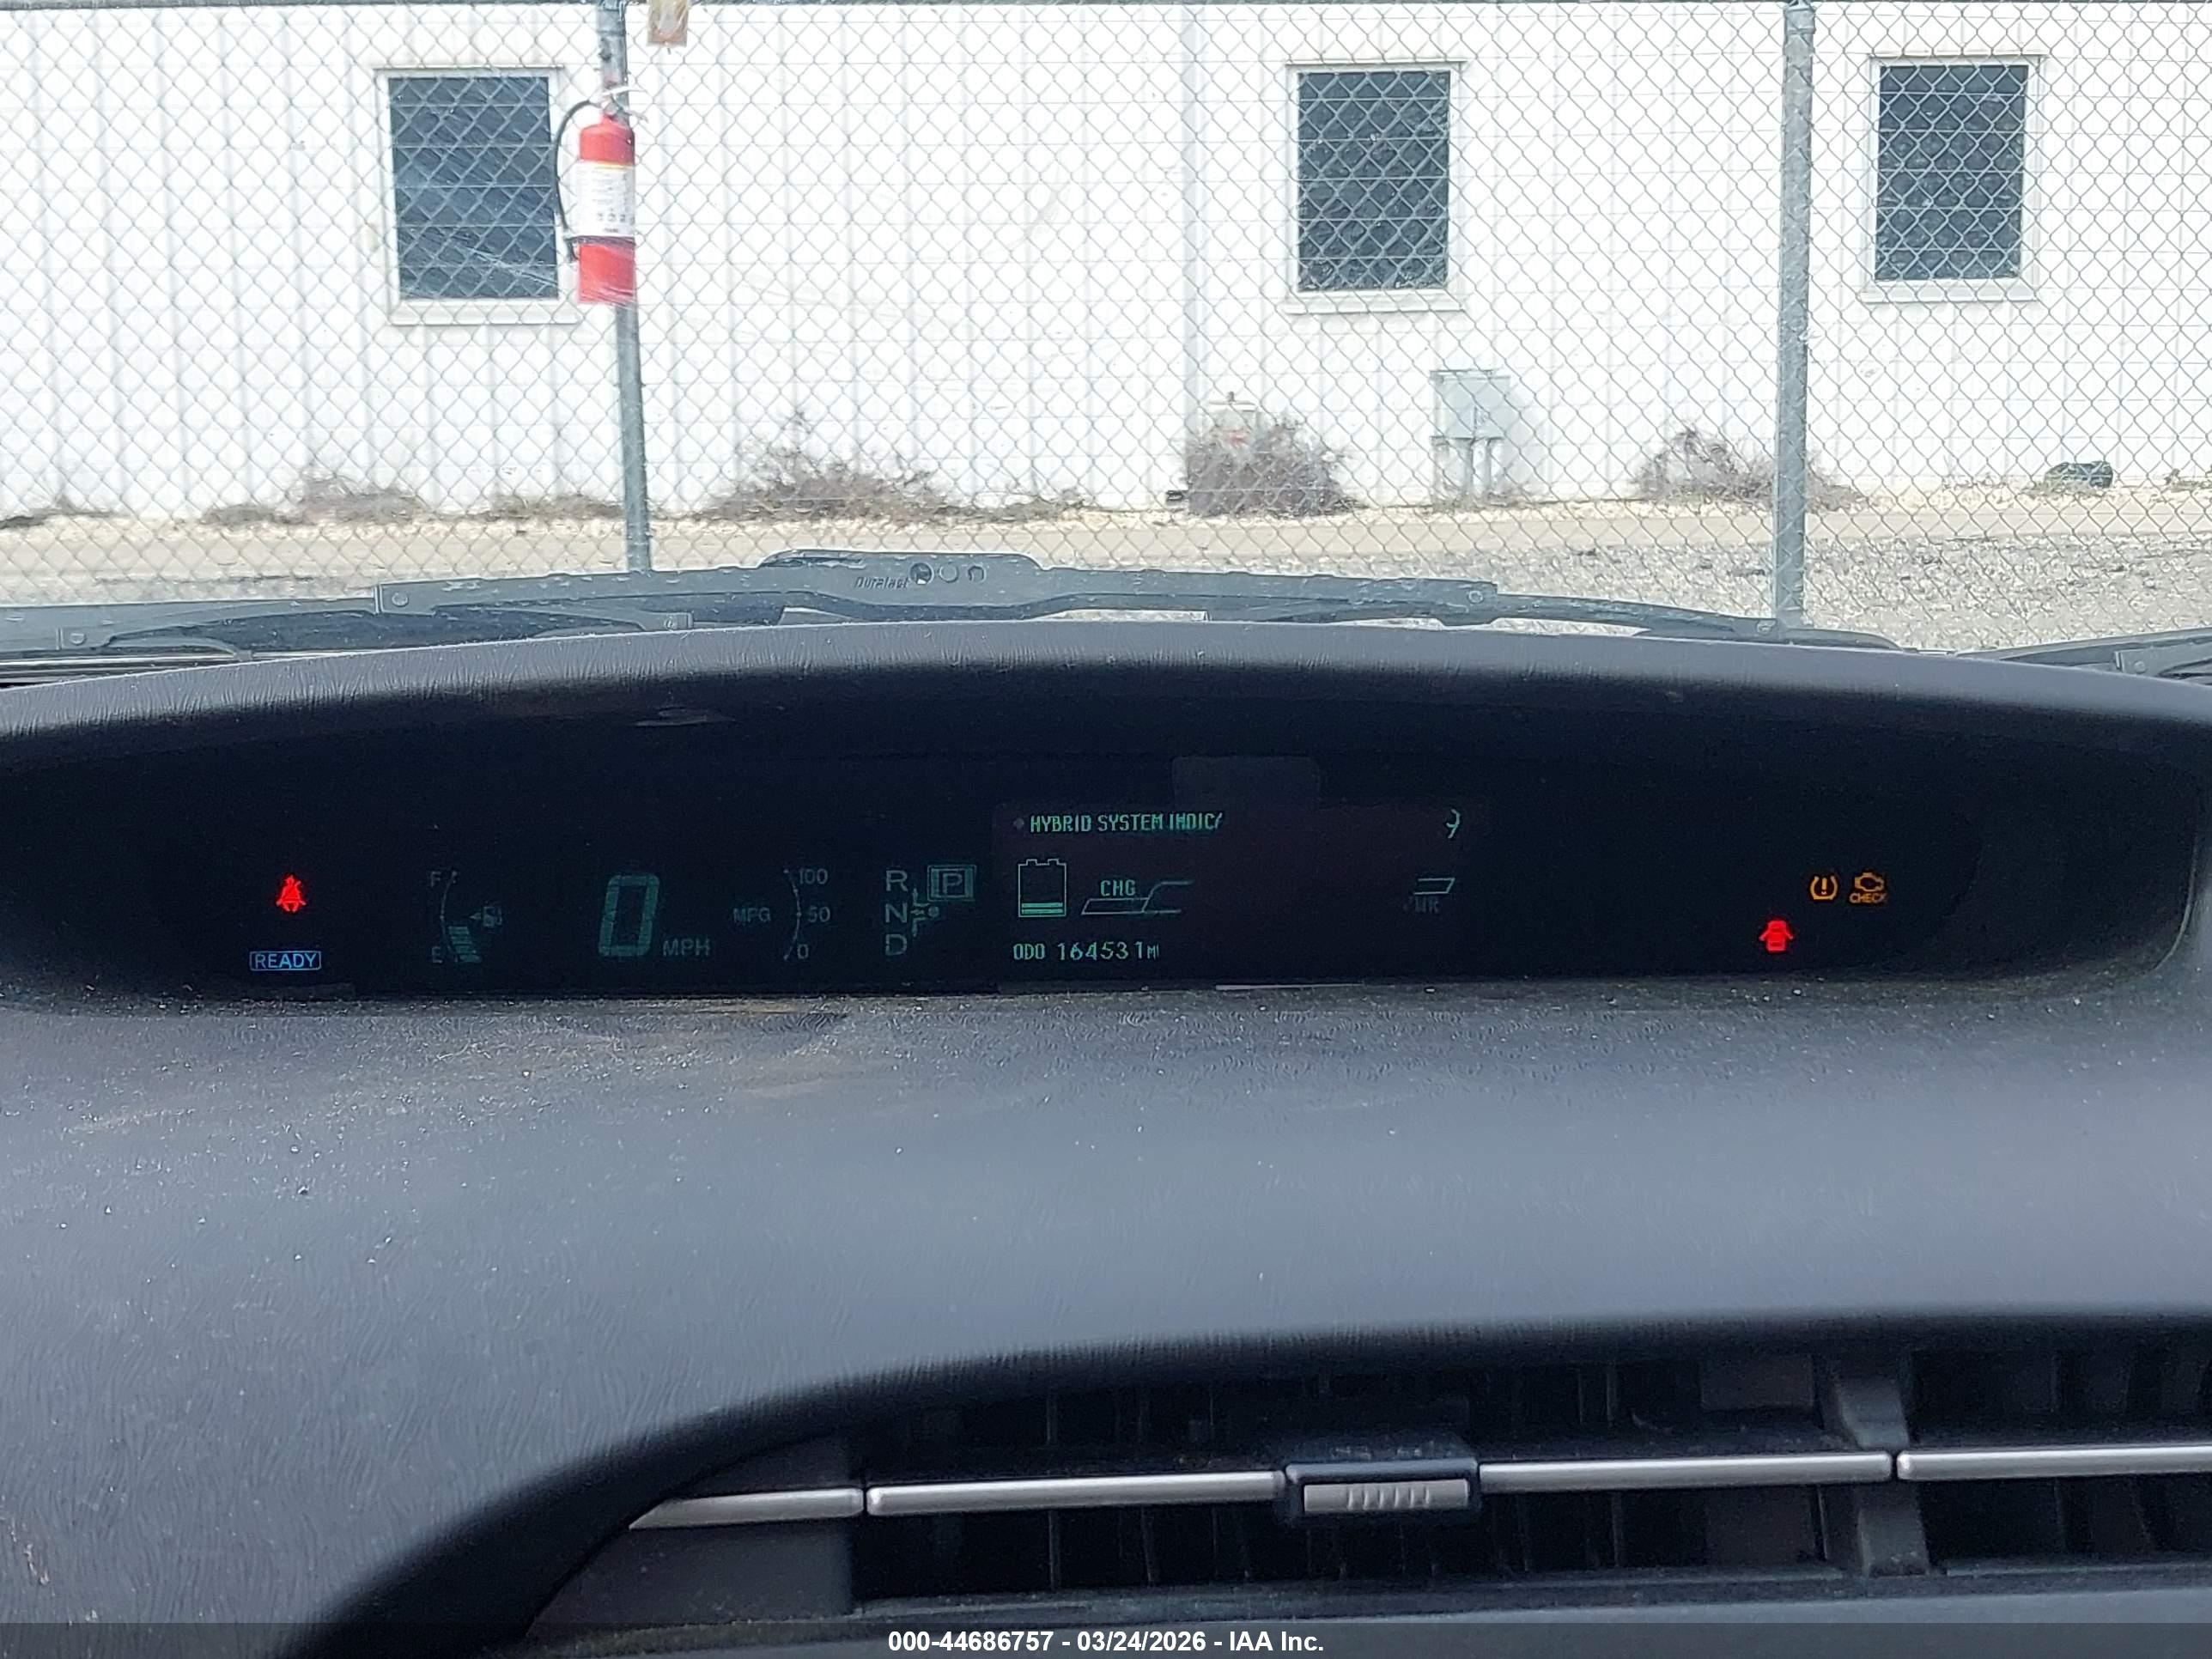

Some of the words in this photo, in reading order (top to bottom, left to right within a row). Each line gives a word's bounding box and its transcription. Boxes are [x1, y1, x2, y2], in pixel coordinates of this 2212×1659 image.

[1030, 814, 1092, 833] HYBRID
[1097, 813, 1163, 832] SYSTEM
[799, 868, 830, 885] 100
[885, 870, 908, 891] R
[943, 872, 963, 895] P
[1099, 879, 1137, 896] CHG
[1848, 892, 1887, 904] CHECK
[599, 874, 660, 957] 0
[806, 906, 831, 923] 50
[885, 902, 908, 923] N
[662, 937, 711, 957] MPH
[885, 934, 908, 956] D
[1012, 943, 1047, 960] ODO
[254, 952, 318, 969] READY
